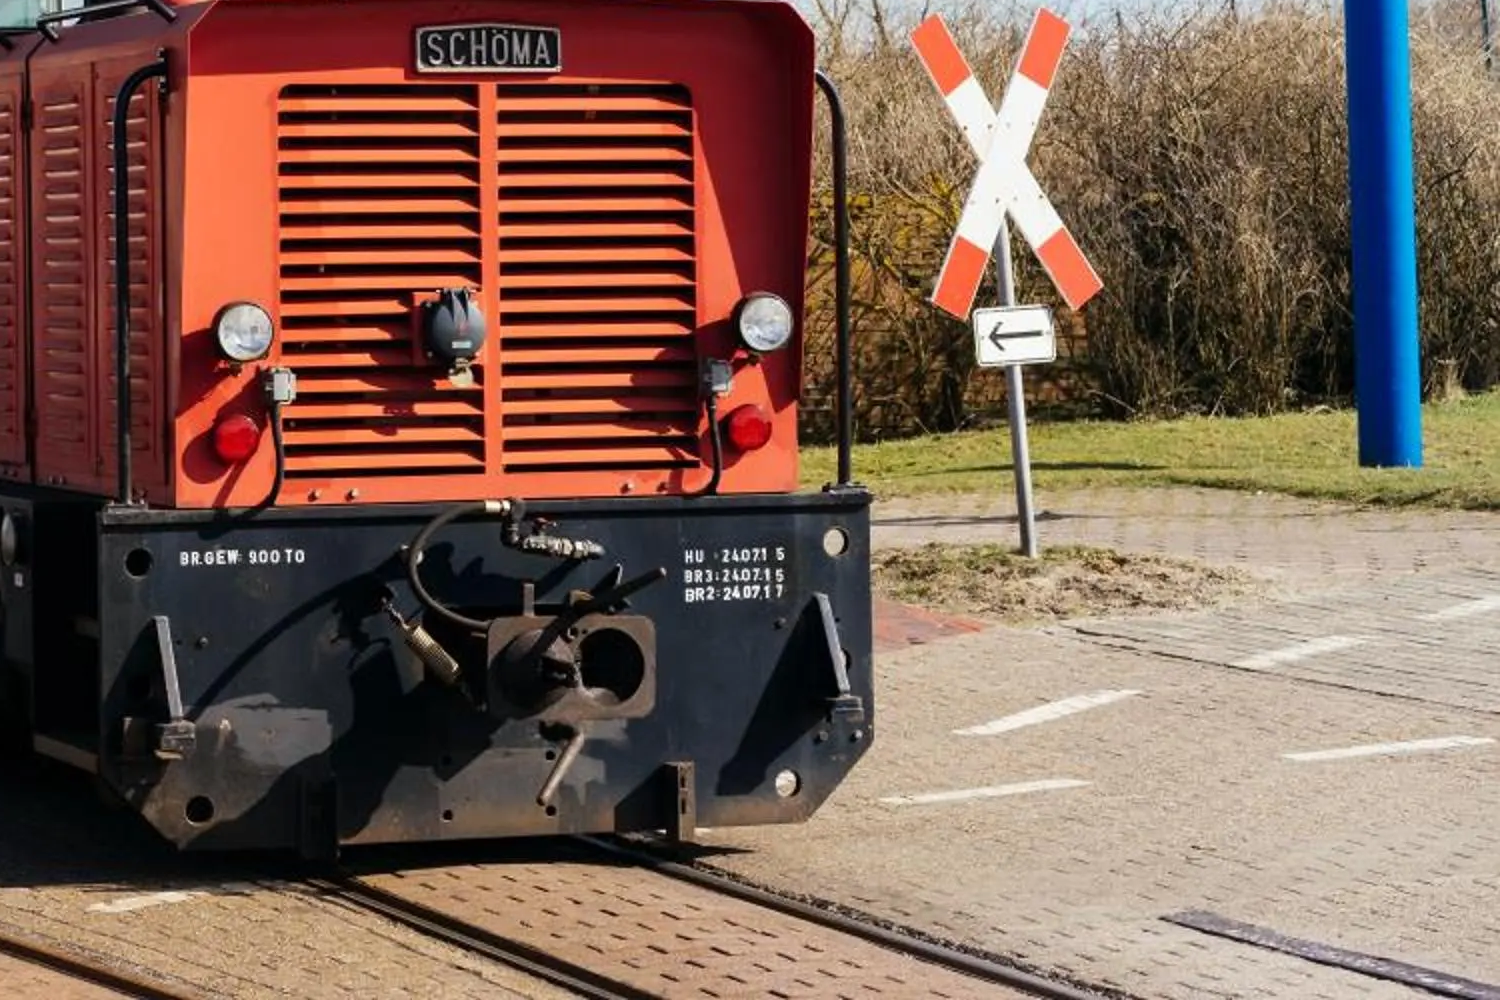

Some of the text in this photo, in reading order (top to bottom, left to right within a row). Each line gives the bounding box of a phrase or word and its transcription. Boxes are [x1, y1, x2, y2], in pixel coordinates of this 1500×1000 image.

[427, 29, 551, 66] SCHÖMA
[284, 548, 306, 564] TO
[685, 549, 705, 564] HU
